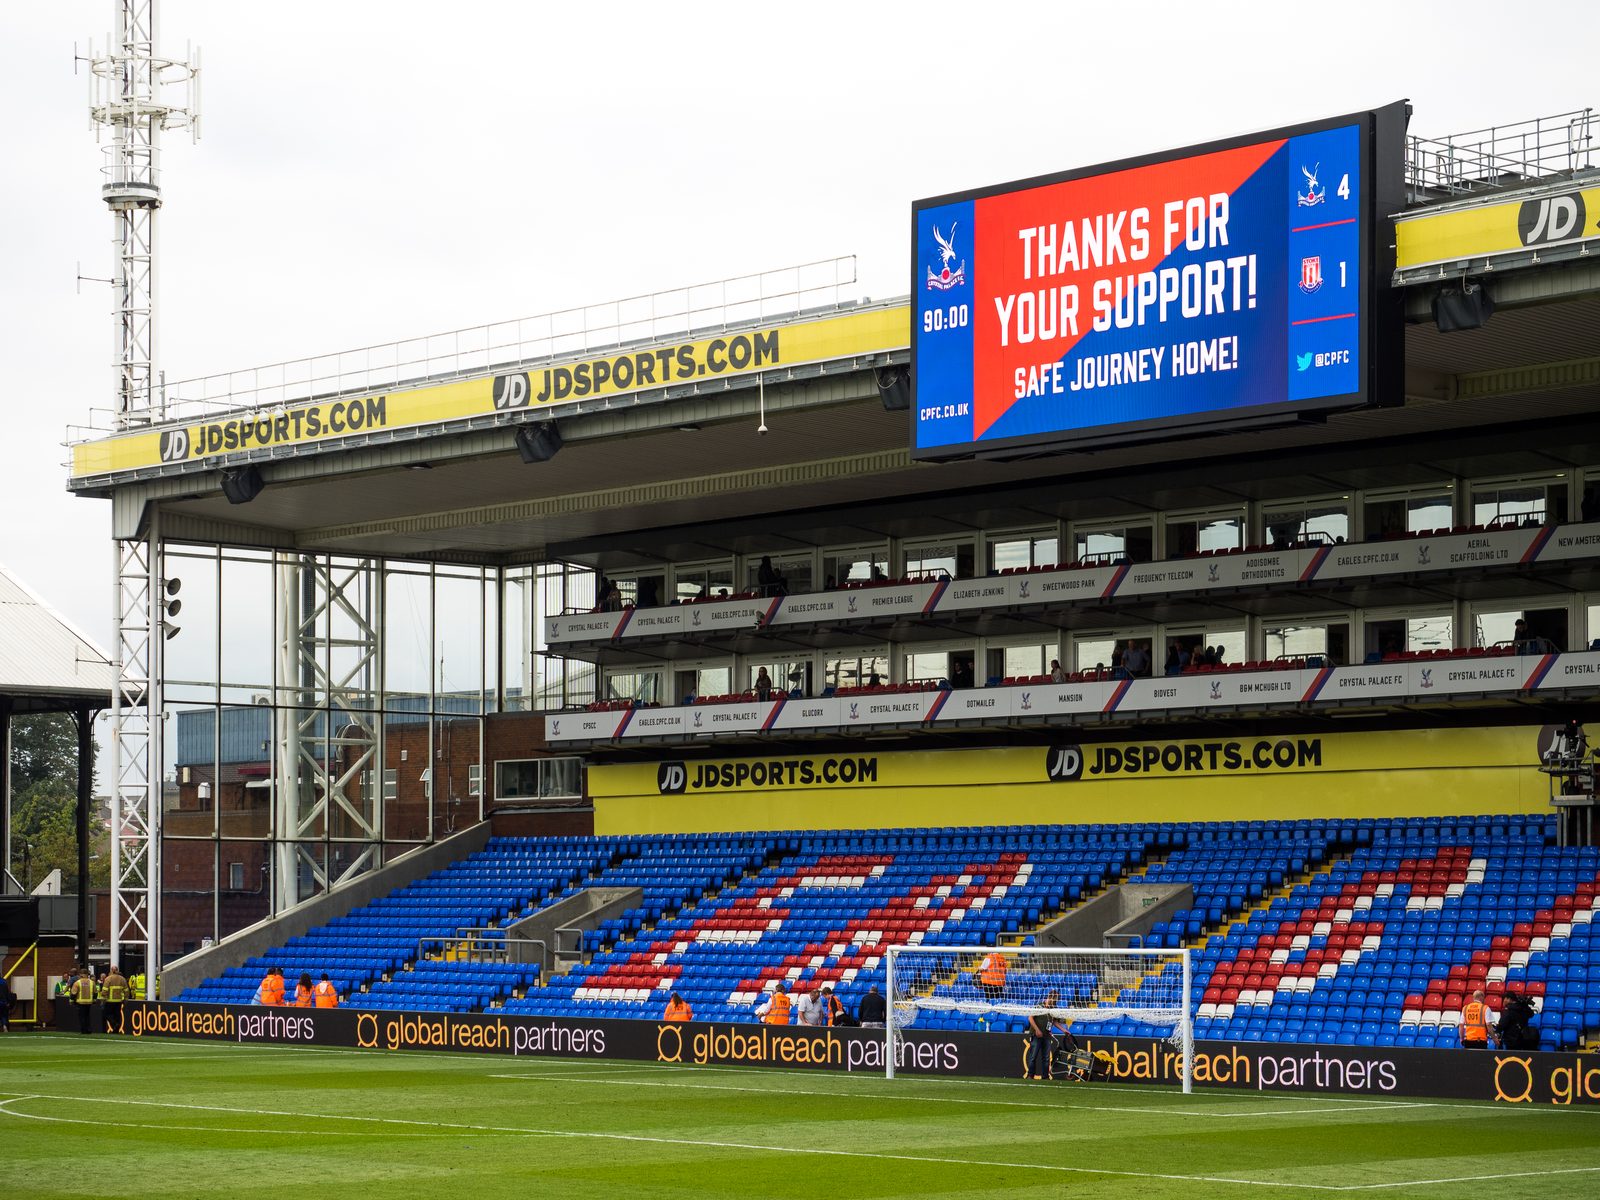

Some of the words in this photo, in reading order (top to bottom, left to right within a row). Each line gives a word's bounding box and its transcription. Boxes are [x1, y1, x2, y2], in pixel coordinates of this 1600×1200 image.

[1338, 174, 1350, 200] 4
[1527, 196, 1577, 244] JD
[1018, 207, 1150, 280] THANKS
[1164, 192, 1230, 256] FOR
[1340, 262, 1346, 288] 1
[994, 284, 1078, 347] YOUR
[1093, 254, 1256, 332] SUPPORT!
[924, 304, 968, 332] 90:00
[1315, 350, 1349, 368] @CPFC
[497, 375, 526, 408] JD
[536, 330, 780, 402] JDSPORTS.COM
[1015, 362, 1064, 399] SAFE
[1070, 347, 1165, 391] JOURNEY
[1172, 336, 1238, 377] HOME!
[920, 403, 969, 421] CPFC.CO.UK
[163, 430, 186, 461] JD
[194, 396, 386, 455] JDSPORTS.COM
[1467, 538, 1490, 549] AERIAL
[1558, 537, 1573, 547] NEW
[1337, 554, 1399, 566] EAGLES.CPFC.CO.UK
[1450, 552, 1494, 562] SCAFFOLDING
[1496, 550, 1509, 559] LTD
[1134, 574, 1166, 583] FREQUENCY
[1167, 570, 1194, 580] TELECOM
[1242, 568, 1284, 580] ORTHODONTICS
[1042, 582, 1080, 592] SWEETWOODS
[1081, 579, 1095, 588] PARK
[954, 589, 981, 599] ELIZABETH
[982, 587, 1004, 597] JENKINS
[872, 597, 893, 606] PREMIER
[894, 594, 913, 604] LEAGUE
[788, 602, 834, 613] EAGLES.CPFC.CO.UK
[711, 609, 755, 620] EAGLES.CPFC.CO.UK
[568, 623, 585, 632] CRYSTAL
[586, 622, 602, 631] PALACE
[637, 617, 654, 626] CRYSTAL
[655, 616, 671, 625] PALACE
[1448, 671, 1477, 681] CRYSTAL
[1479, 670, 1504, 679] PALACE
[1506, 669, 1515, 678] FC
[1565, 664, 1595, 674] CRYSTAL
[1255, 682, 1279, 692] MCHUGH
[1280, 682, 1291, 690] LTD
[1339, 677, 1366, 687] CRYSTAL
[1368, 676, 1392, 686] PALACE
[1394, 676, 1402, 684] FC
[1058, 694, 1082, 703] MANSION
[1154, 689, 1177, 698] BIDVEST
[870, 705, 891, 713] CRYSTAL
[892, 704, 911, 712] PALACE
[967, 699, 995, 708] DOTMAILER
[639, 717, 681, 726] EAGLES.CPFC.CO.UK
[712, 714, 732, 722] CRYSTAL
[751, 712, 757, 720] FC
[1051, 749, 1080, 776] JD
[1089, 739, 1322, 774] JDSPORTS.COM
[661, 766, 684, 790] JD
[692, 758, 878, 788] JDSPORTS.COM
[132, 1006, 184, 1036] global
[186, 1008, 234, 1035] reach
[238, 1010, 314, 1042] partners
[387, 1015, 448, 1050] global
[452, 1018, 509, 1048] reach
[515, 1022, 605, 1056] partners
[694, 1026, 767, 1064] global
[772, 1030, 841, 1064] reach
[1258, 1051, 1397, 1090] partners
